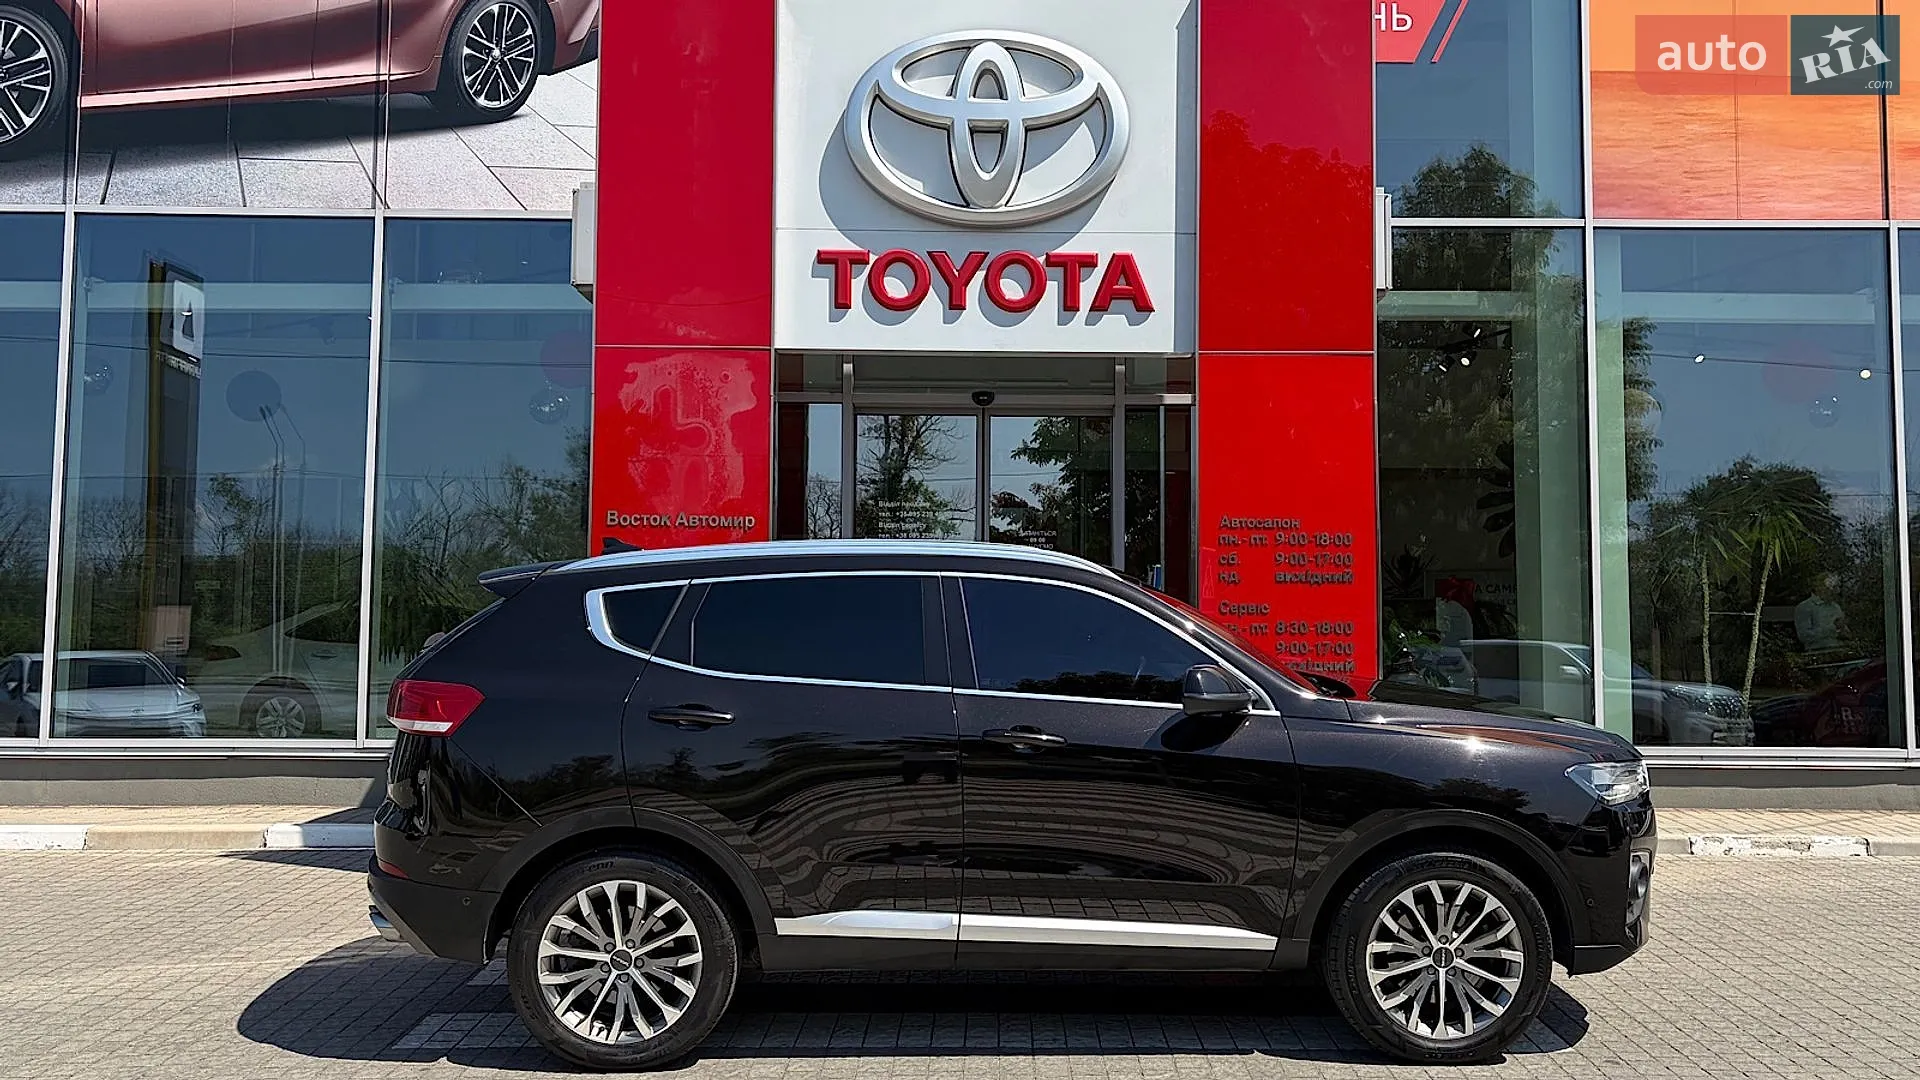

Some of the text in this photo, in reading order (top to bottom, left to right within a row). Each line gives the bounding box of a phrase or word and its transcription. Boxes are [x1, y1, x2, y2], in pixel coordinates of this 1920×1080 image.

[816, 248, 1155, 313] TOYOTA
[607, 511, 756, 532] Восток Автомир
[1220, 515, 1301, 529] Автосалон
[1275, 551, 1353, 566] 9:00-17:00
[1276, 568, 1353, 585] вихідний
[1220, 600, 1271, 616] Сервіс
[1275, 621, 1354, 635] 8:30-18:00
[1275, 640, 1354, 655] 9:00-17:00
[1282, 657, 1355, 673] ихідний
